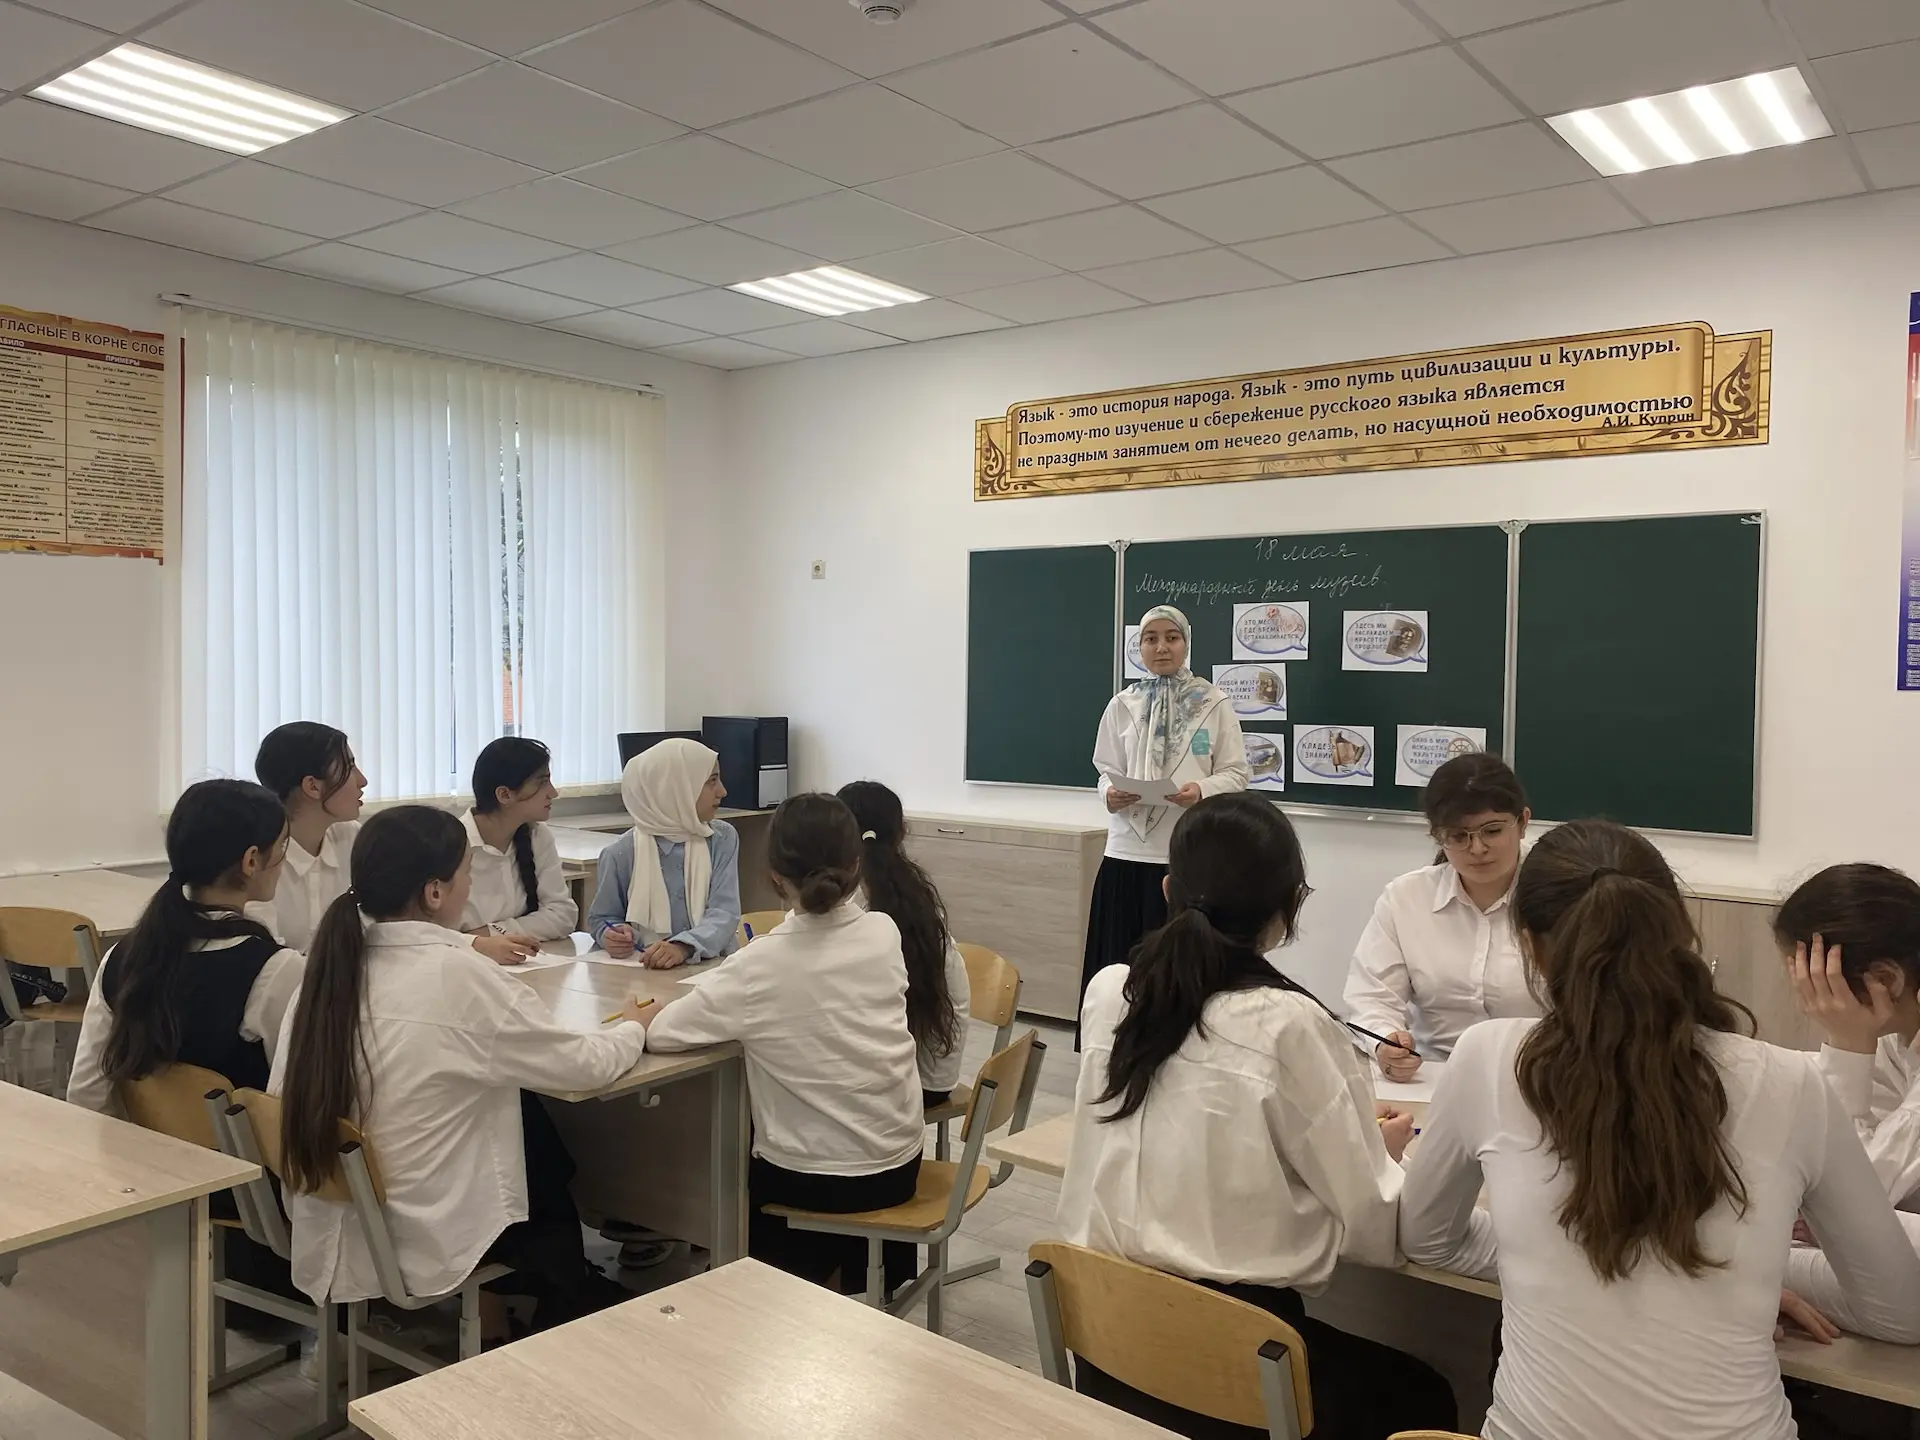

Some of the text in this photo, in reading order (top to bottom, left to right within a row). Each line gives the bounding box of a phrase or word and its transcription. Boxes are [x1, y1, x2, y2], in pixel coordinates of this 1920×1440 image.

[0, 318, 67, 340] ГЛАСНЫЕ
[72, 331, 80, 341] В
[84, 333, 128, 350] КОРНЕ
[105, 355, 140, 366] ПРИМЕРЫ
[1018, 407, 1055, 424] Язык
[1068, 406, 1098, 418] это
[1102, 397, 1169, 415] история
[1174, 389, 1235, 409] народа.
[1241, 379, 1287, 398] Язык
[1304, 377, 1340, 391] это
[1346, 370, 1395, 391] путь
[1401, 355, 1532, 383] цивилизации
[1540, 352, 1551, 366] и
[1559, 340, 1681, 367] культуры.
[1018, 379, 1566, 446] Поэтому-то изучение и сбережение русского языка является
[1602, 412, 1695, 428] А.И. Куприн
[1017, 395, 1693, 468] не праздным занятием от нечего делать, но насущной необходимостью
[1255, 538, 1278, 561] 18
[1135, 573, 1257, 606] Международный
